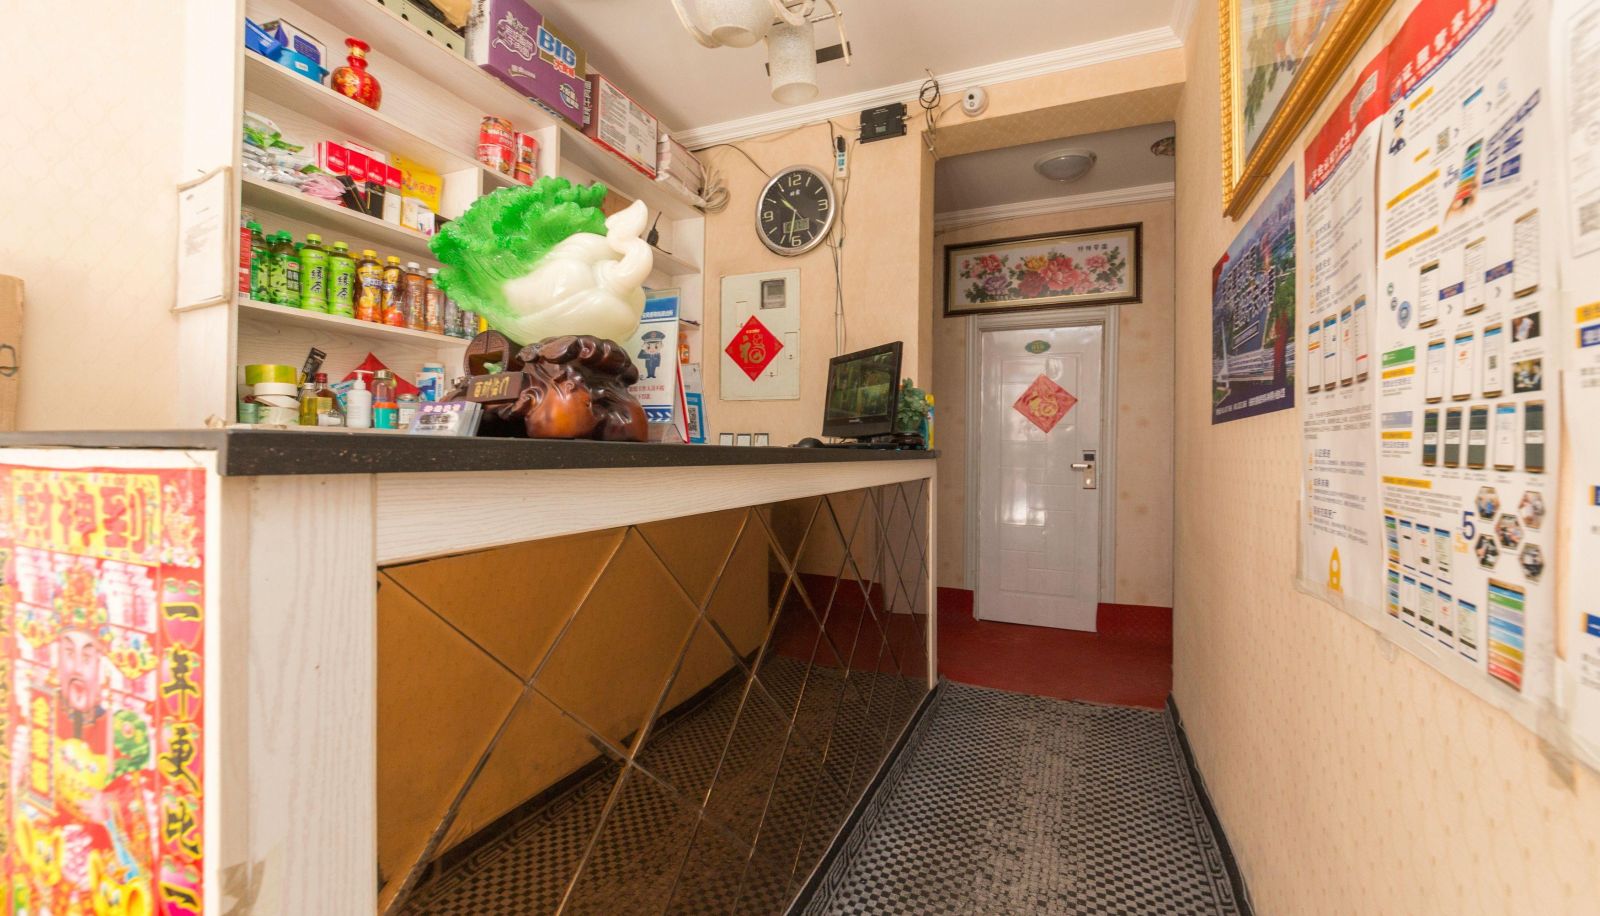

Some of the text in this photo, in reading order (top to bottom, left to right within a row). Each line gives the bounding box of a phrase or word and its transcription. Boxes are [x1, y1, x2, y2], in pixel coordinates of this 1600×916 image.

[538, 26, 576, 68] BIG
[789, 174, 802, 187] 12
[817, 199, 828, 211] 3
[762, 210, 774, 222] 9
[791, 235, 802, 247] 6
[1463, 511, 1475, 540] 5
